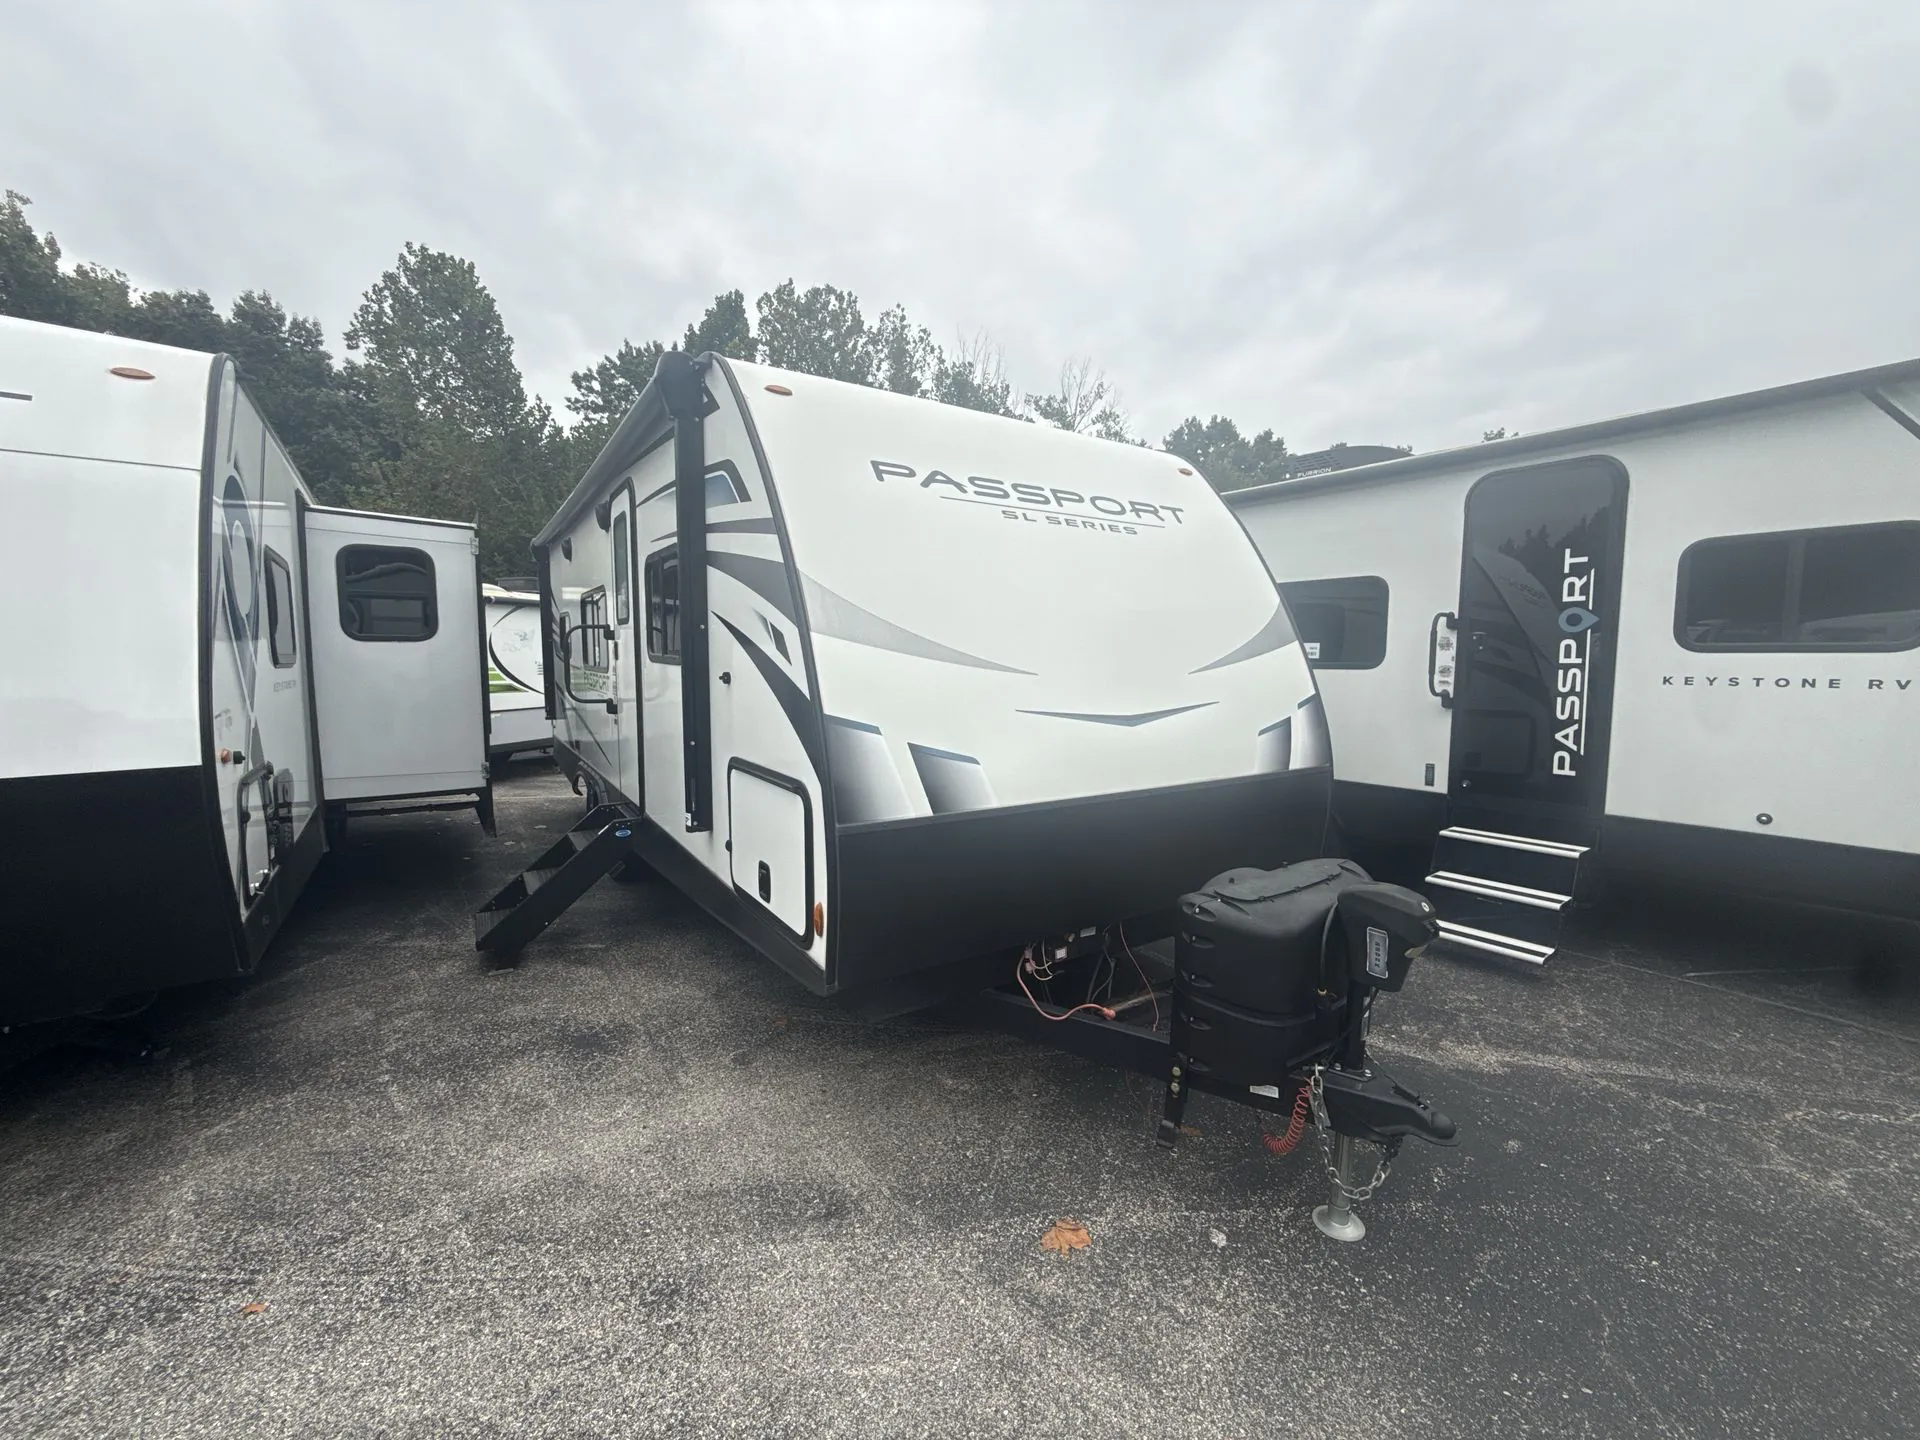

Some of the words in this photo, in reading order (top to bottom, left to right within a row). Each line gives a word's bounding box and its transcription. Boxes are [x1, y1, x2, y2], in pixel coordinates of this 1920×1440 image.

[870, 460, 1184, 524] PASSPORT
[1001, 509, 1037, 522] SL
[1046, 515, 1138, 535] SERIES
[1552, 548, 1590, 777] PASSPORT
[1662, 676, 1841, 689] KEYSTONE
[1867, 679, 1912, 690] RV
